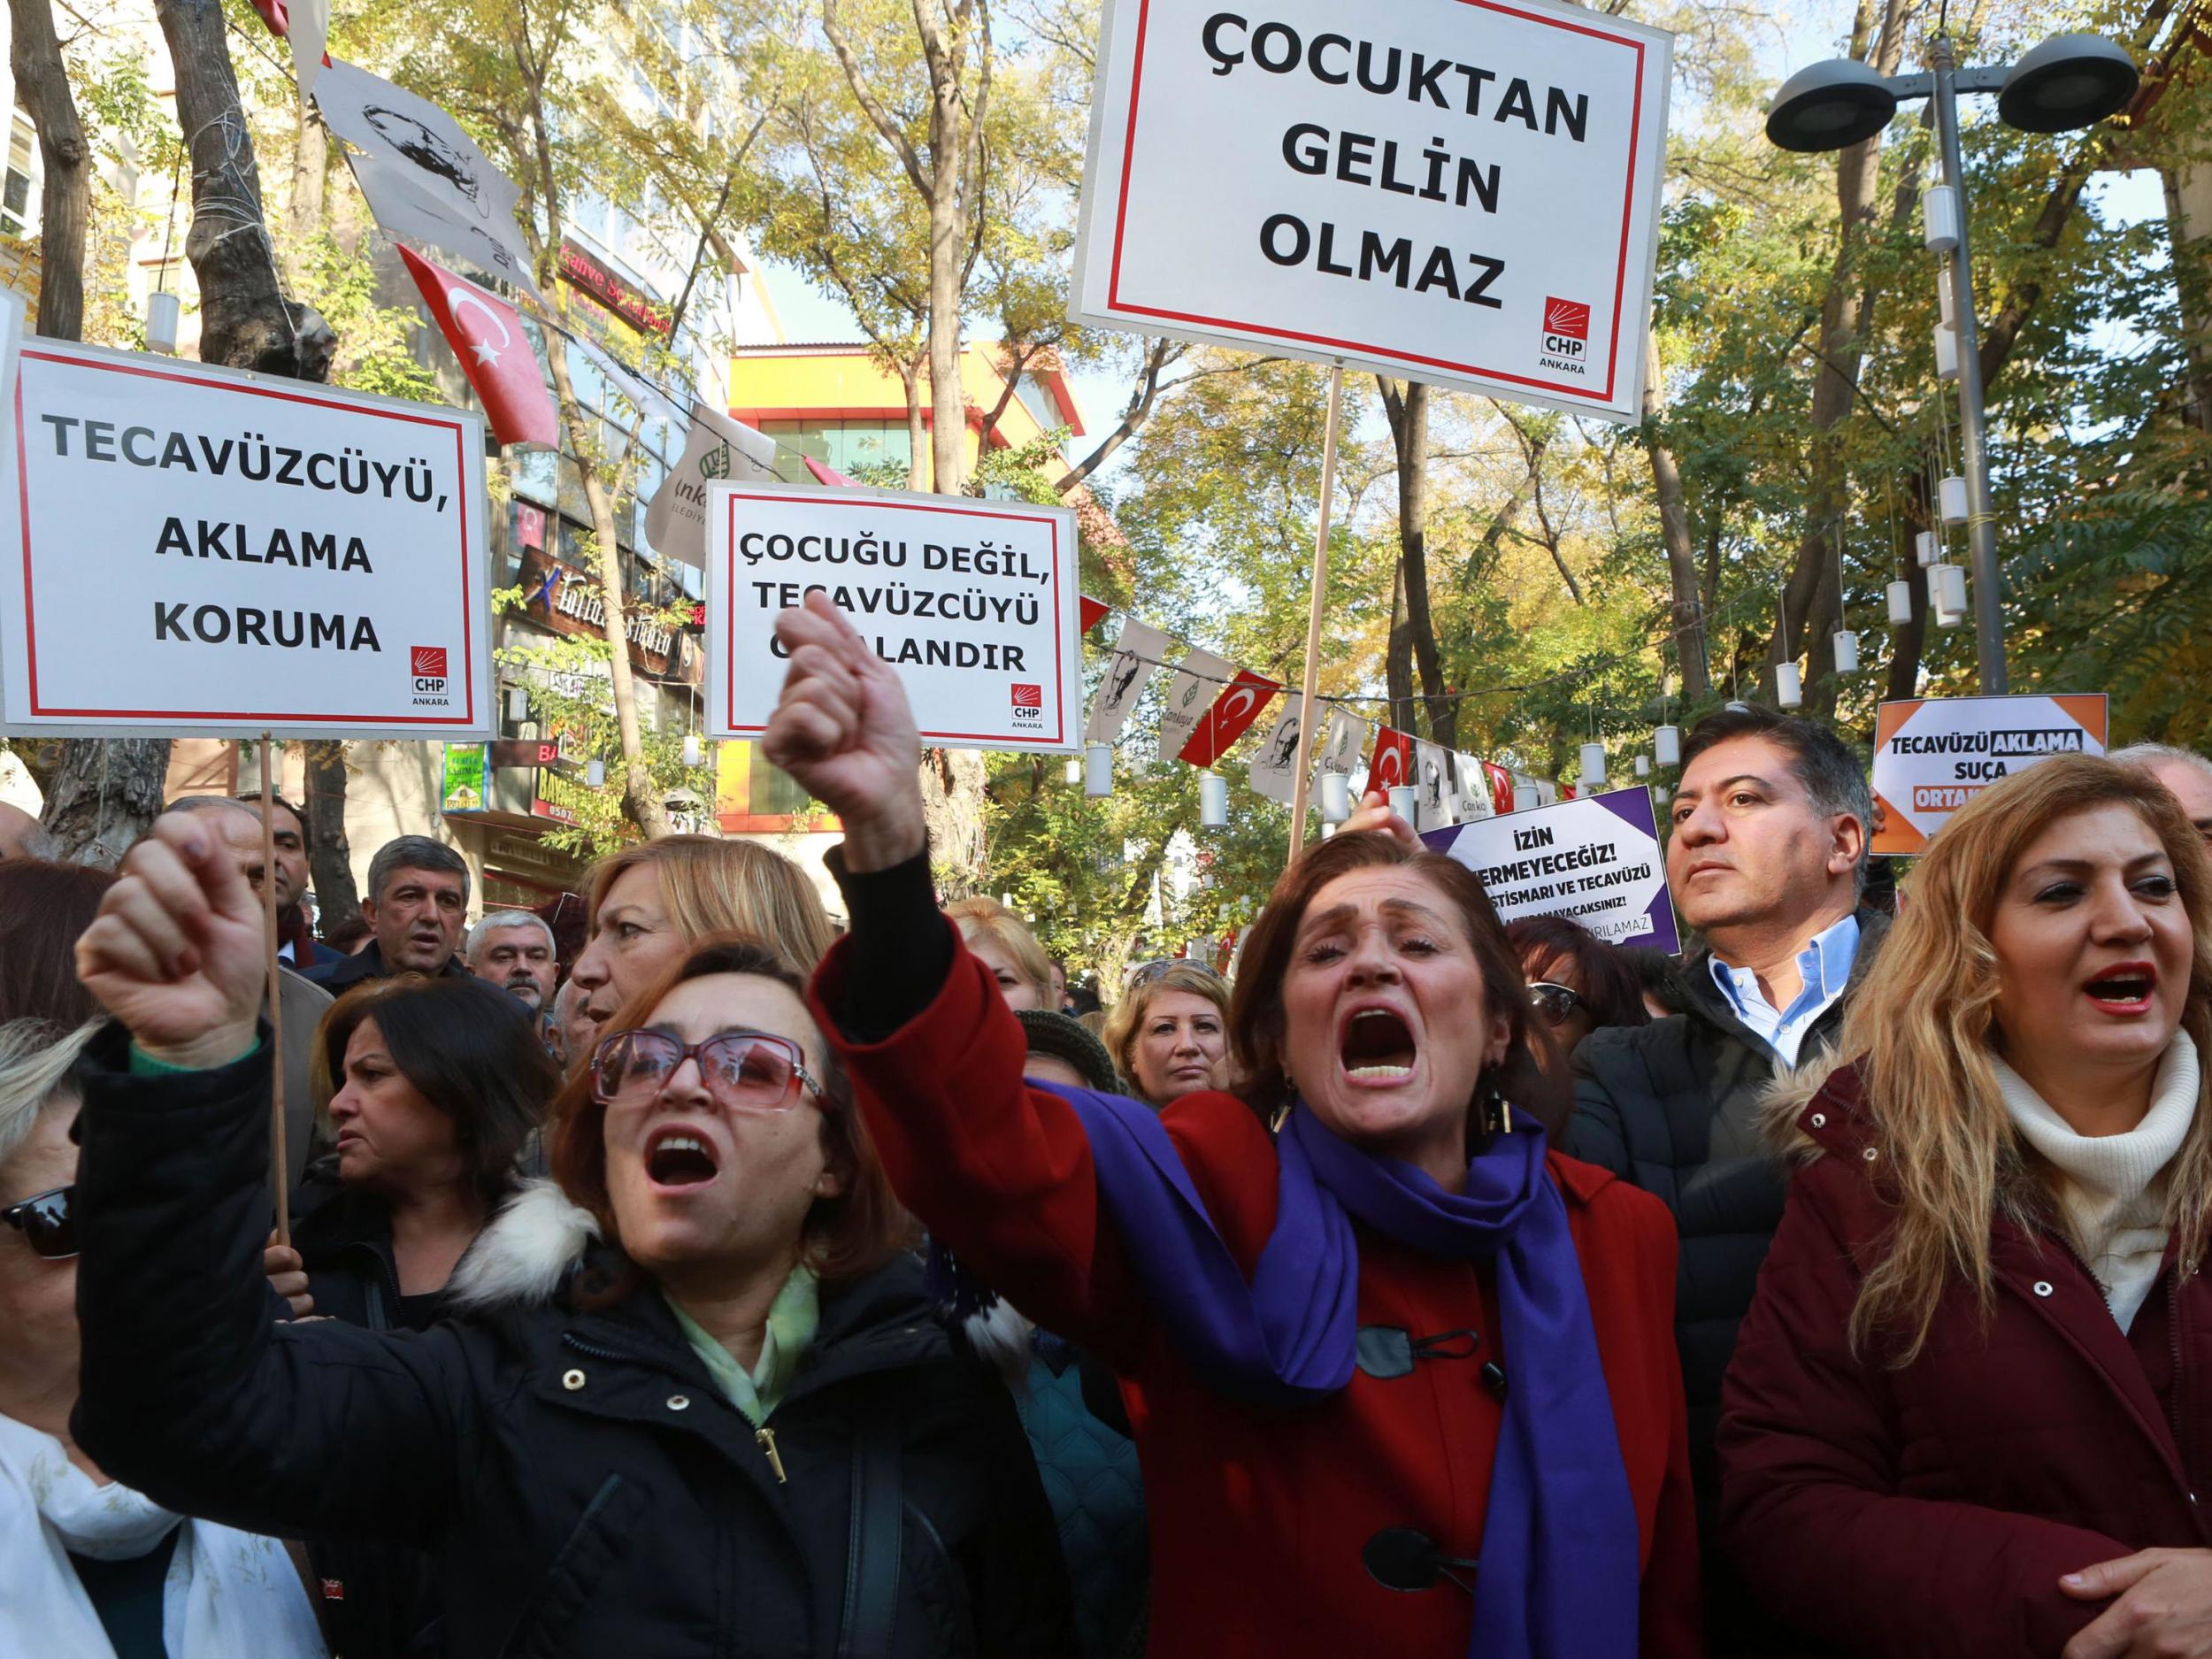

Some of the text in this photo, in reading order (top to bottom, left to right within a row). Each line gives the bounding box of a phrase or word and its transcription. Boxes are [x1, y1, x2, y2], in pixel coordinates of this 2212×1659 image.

[1202, 12, 1589, 143] ÇOCUKTAN
[1281, 122, 1502, 214] GELİN
[1259, 213, 1506, 310] OLMAZ
[1540, 357, 1586, 375] ANKARA
[1546, 335, 1583, 356] CHP
[42, 413, 449, 513] TECAVÜZCÜYÜ,
[155, 516, 373, 574] AKLAMA
[739, 530, 1050, 586] ÇOCUĞU DEĞİL,
[154, 602, 382, 653] KORUMA
[412, 697, 449, 706] ANKARA
[415, 678, 445, 692] CHP
[1014, 707, 1040, 718] CHP
[1891, 731, 2081, 755] TECAVÜZÜ AKLAMA
[1954, 761, 2008, 782] SUÇA
[1513, 826, 1555, 852] İZİN
[1472, 842, 1617, 887] ERMEYECEĞİZ!
[1490, 863, 1652, 908] STİSMARI VE TECAVÜZÜ
